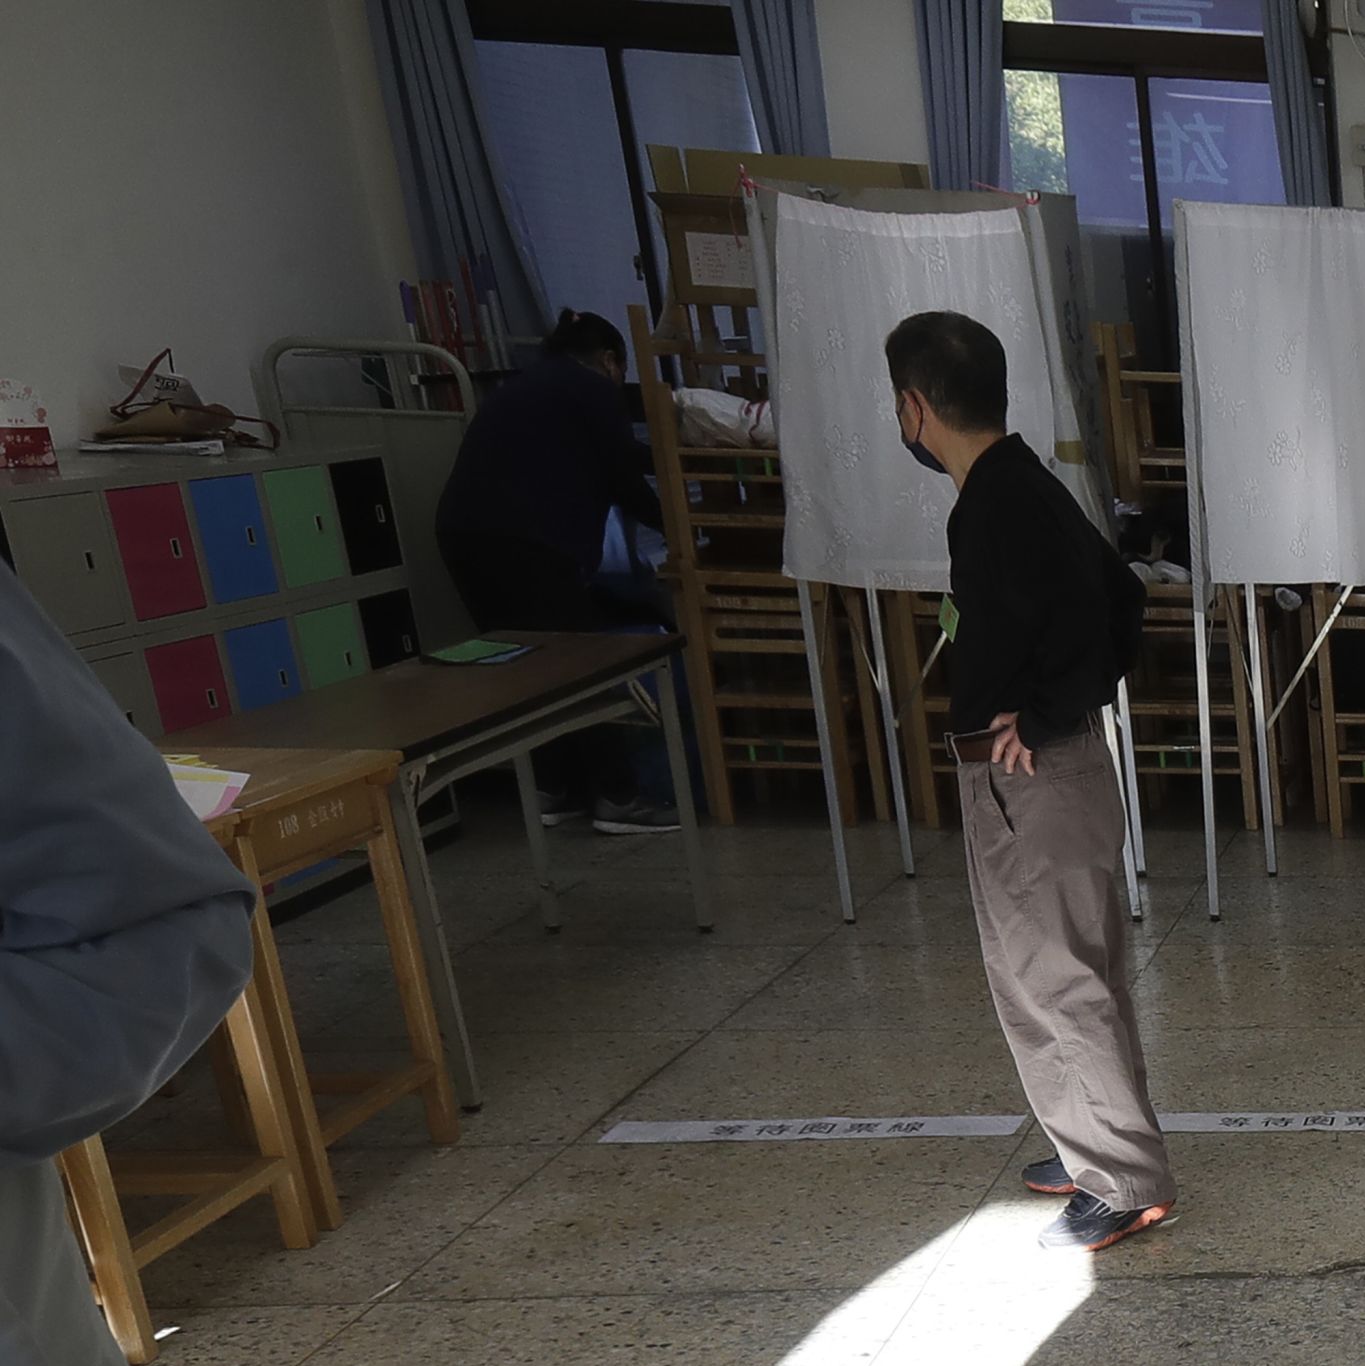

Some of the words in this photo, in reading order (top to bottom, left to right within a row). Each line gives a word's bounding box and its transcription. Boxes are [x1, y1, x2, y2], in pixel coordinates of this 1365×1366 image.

[707, 1121, 926, 1136] 等待圈票線
